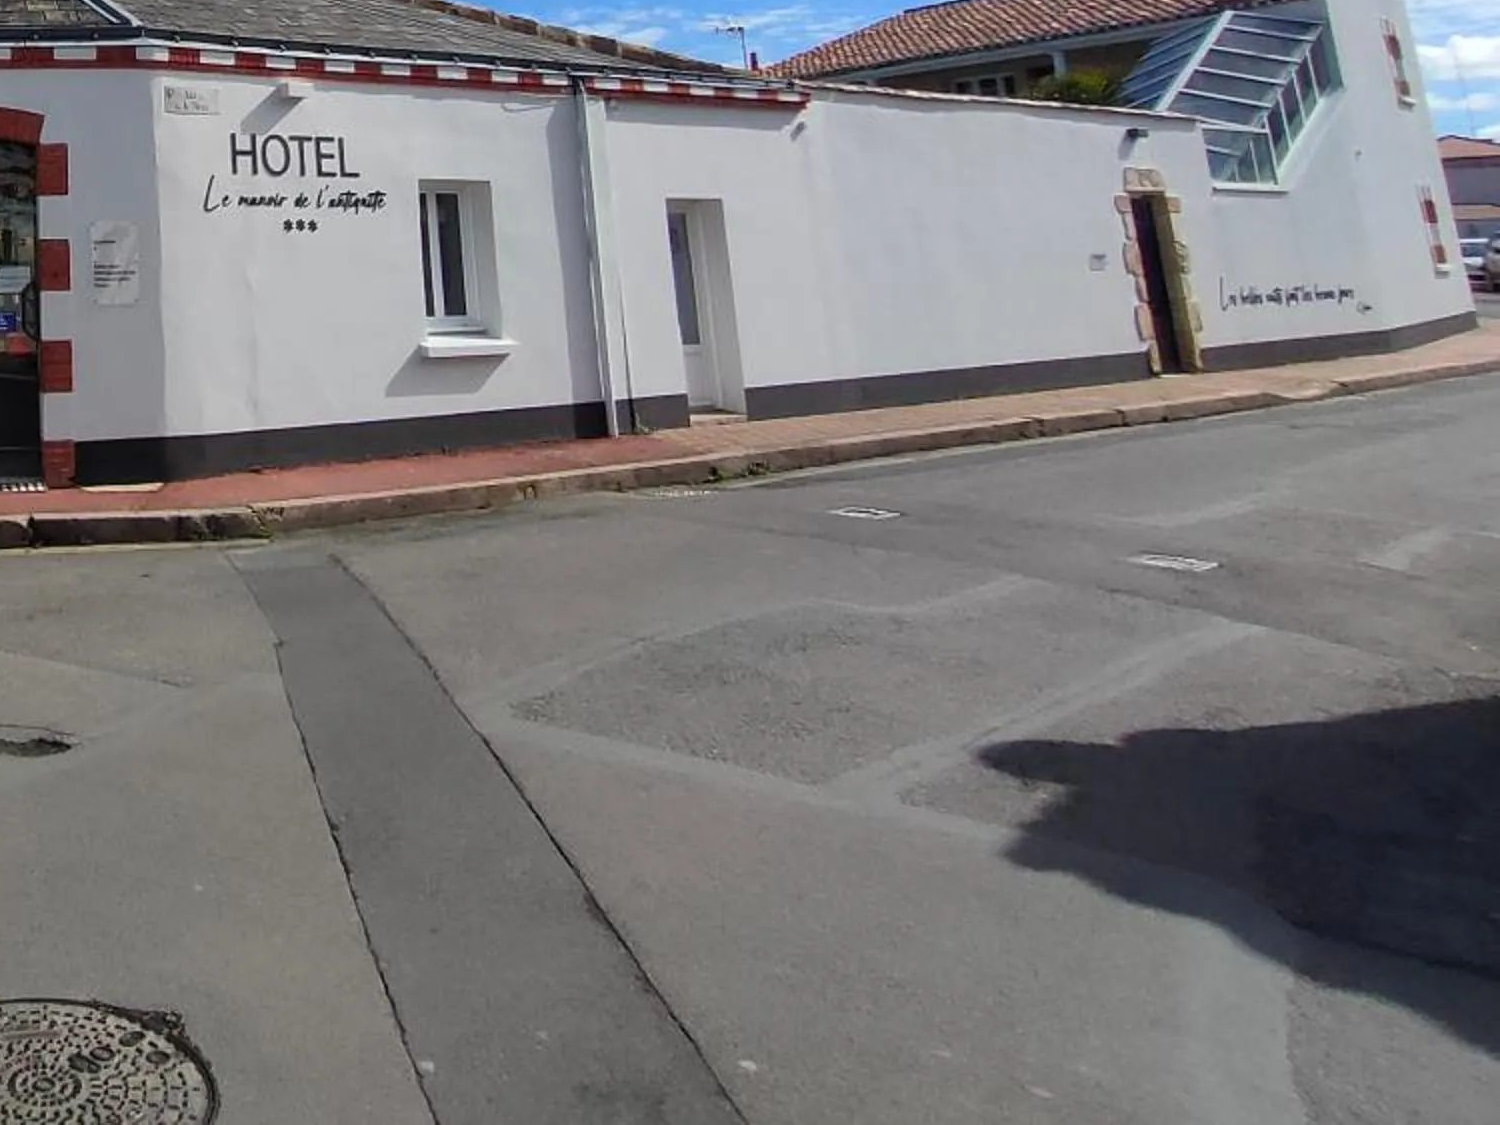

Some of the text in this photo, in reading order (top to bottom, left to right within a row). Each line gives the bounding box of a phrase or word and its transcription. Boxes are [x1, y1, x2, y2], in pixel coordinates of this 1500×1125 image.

[229, 132, 361, 178] HOTEL
[203, 174, 231, 212] Le
[237, 193, 288, 207] manoir
[294, 192, 309, 208] de
